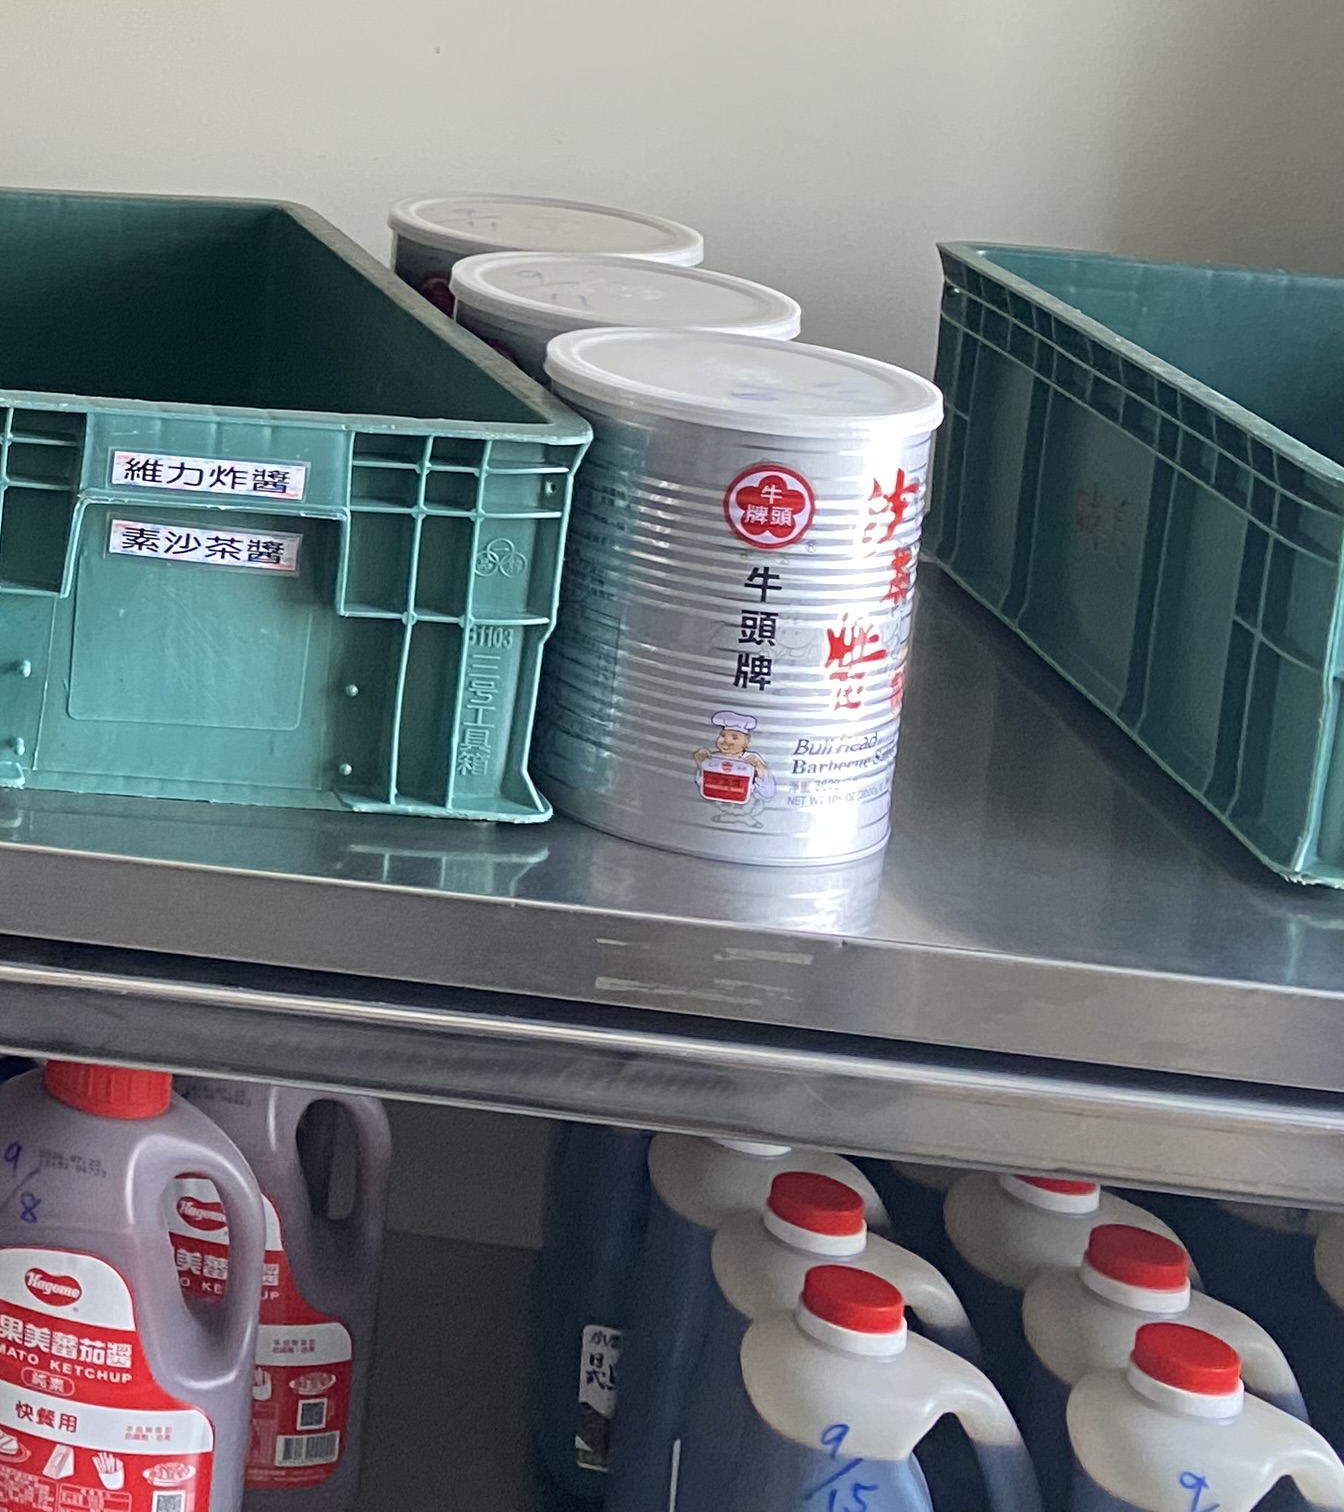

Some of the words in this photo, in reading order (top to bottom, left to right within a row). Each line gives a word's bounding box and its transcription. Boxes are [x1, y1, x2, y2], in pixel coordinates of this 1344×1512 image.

[123, 457, 291, 495] 維力炸醬
[121, 526, 286, 565] 素沙茶醬
[732, 566, 783, 691] 牛頭牌
[26, 1271, 81, 1299] Kagome
[49, 1359, 133, 1385] KETCHUP
[15, 1399, 79, 1434] 快餐用
